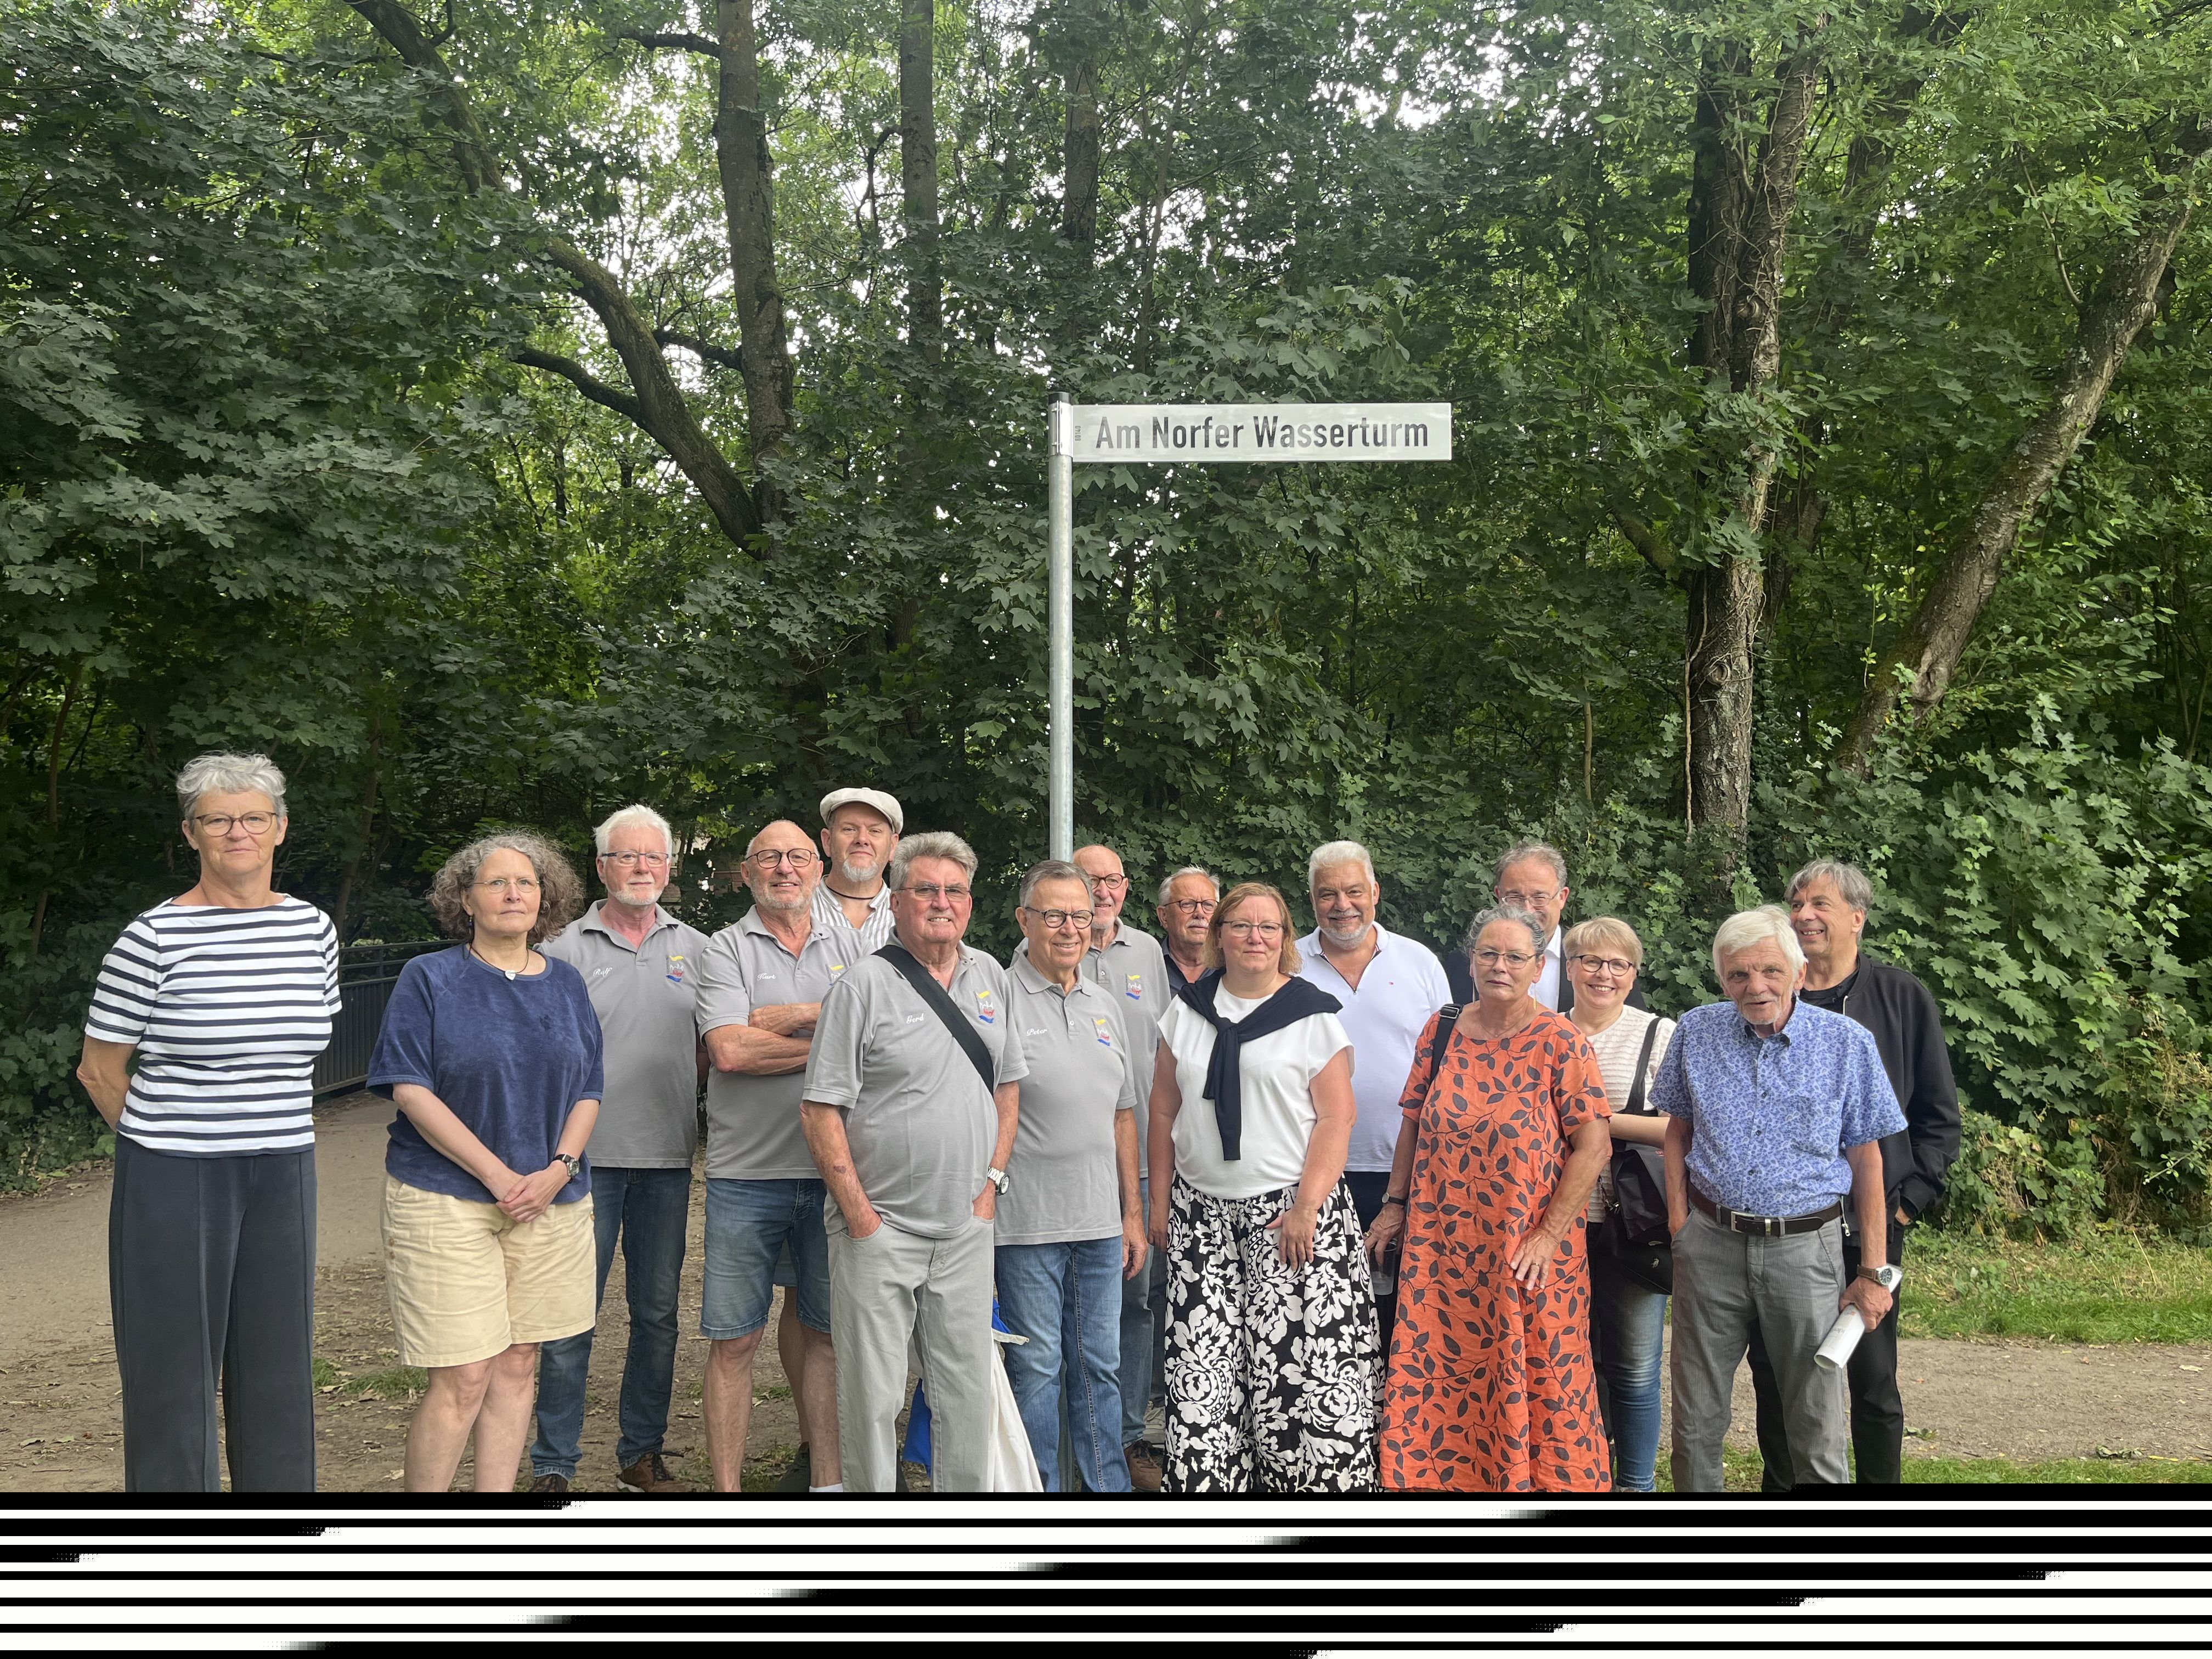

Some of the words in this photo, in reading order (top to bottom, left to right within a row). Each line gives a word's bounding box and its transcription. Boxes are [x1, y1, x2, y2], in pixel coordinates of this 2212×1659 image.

[1096, 416, 1140, 449] Am
[1152, 415, 1244, 449] Norfer
[1253, 415, 1429, 448] Wasserturm
[593, 967, 613, 977] Ralf
[757, 973, 776, 981] Kurt
[906, 1013, 924, 1024] Gerd
